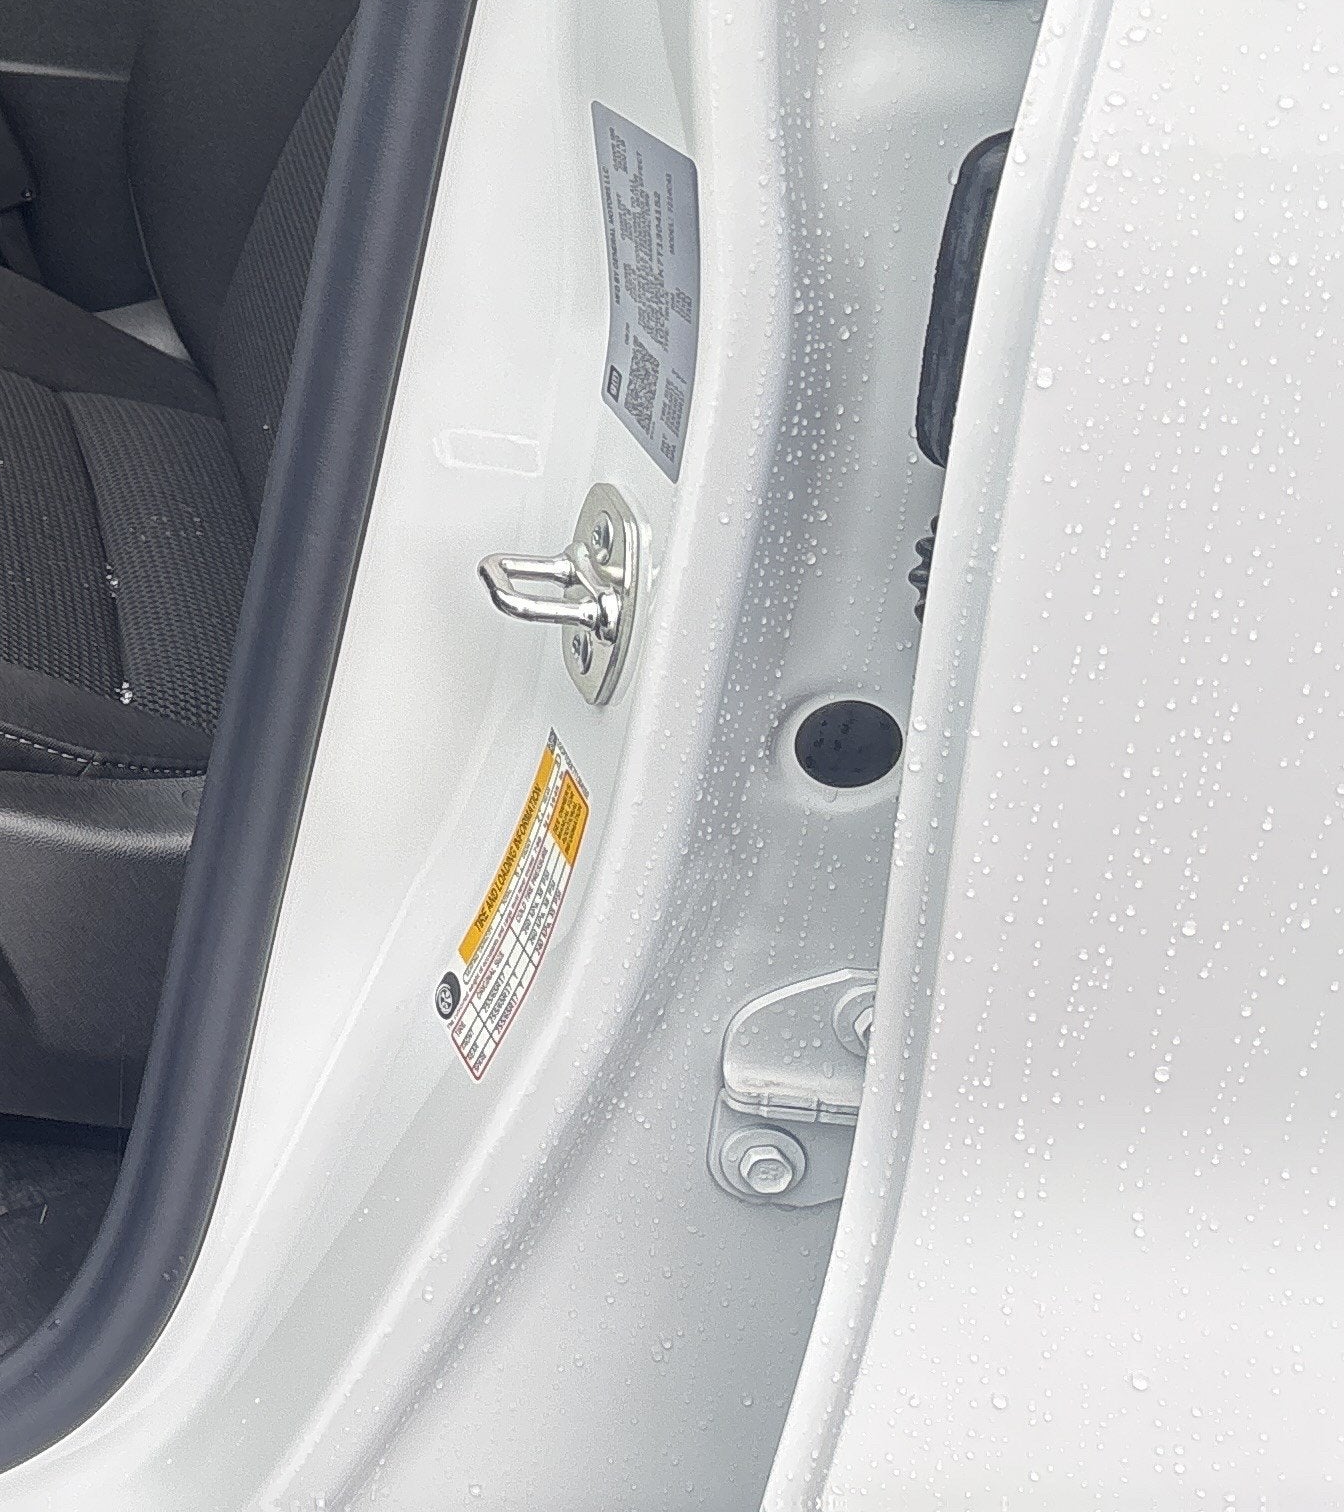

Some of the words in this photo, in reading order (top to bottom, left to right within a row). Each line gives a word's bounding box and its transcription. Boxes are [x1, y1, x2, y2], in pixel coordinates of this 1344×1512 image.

[474, 909, 489, 932] TIRE
[484, 889, 499, 912] AND
[495, 846, 518, 894] LOADING
[511, 783, 543, 849] INFORMATION
